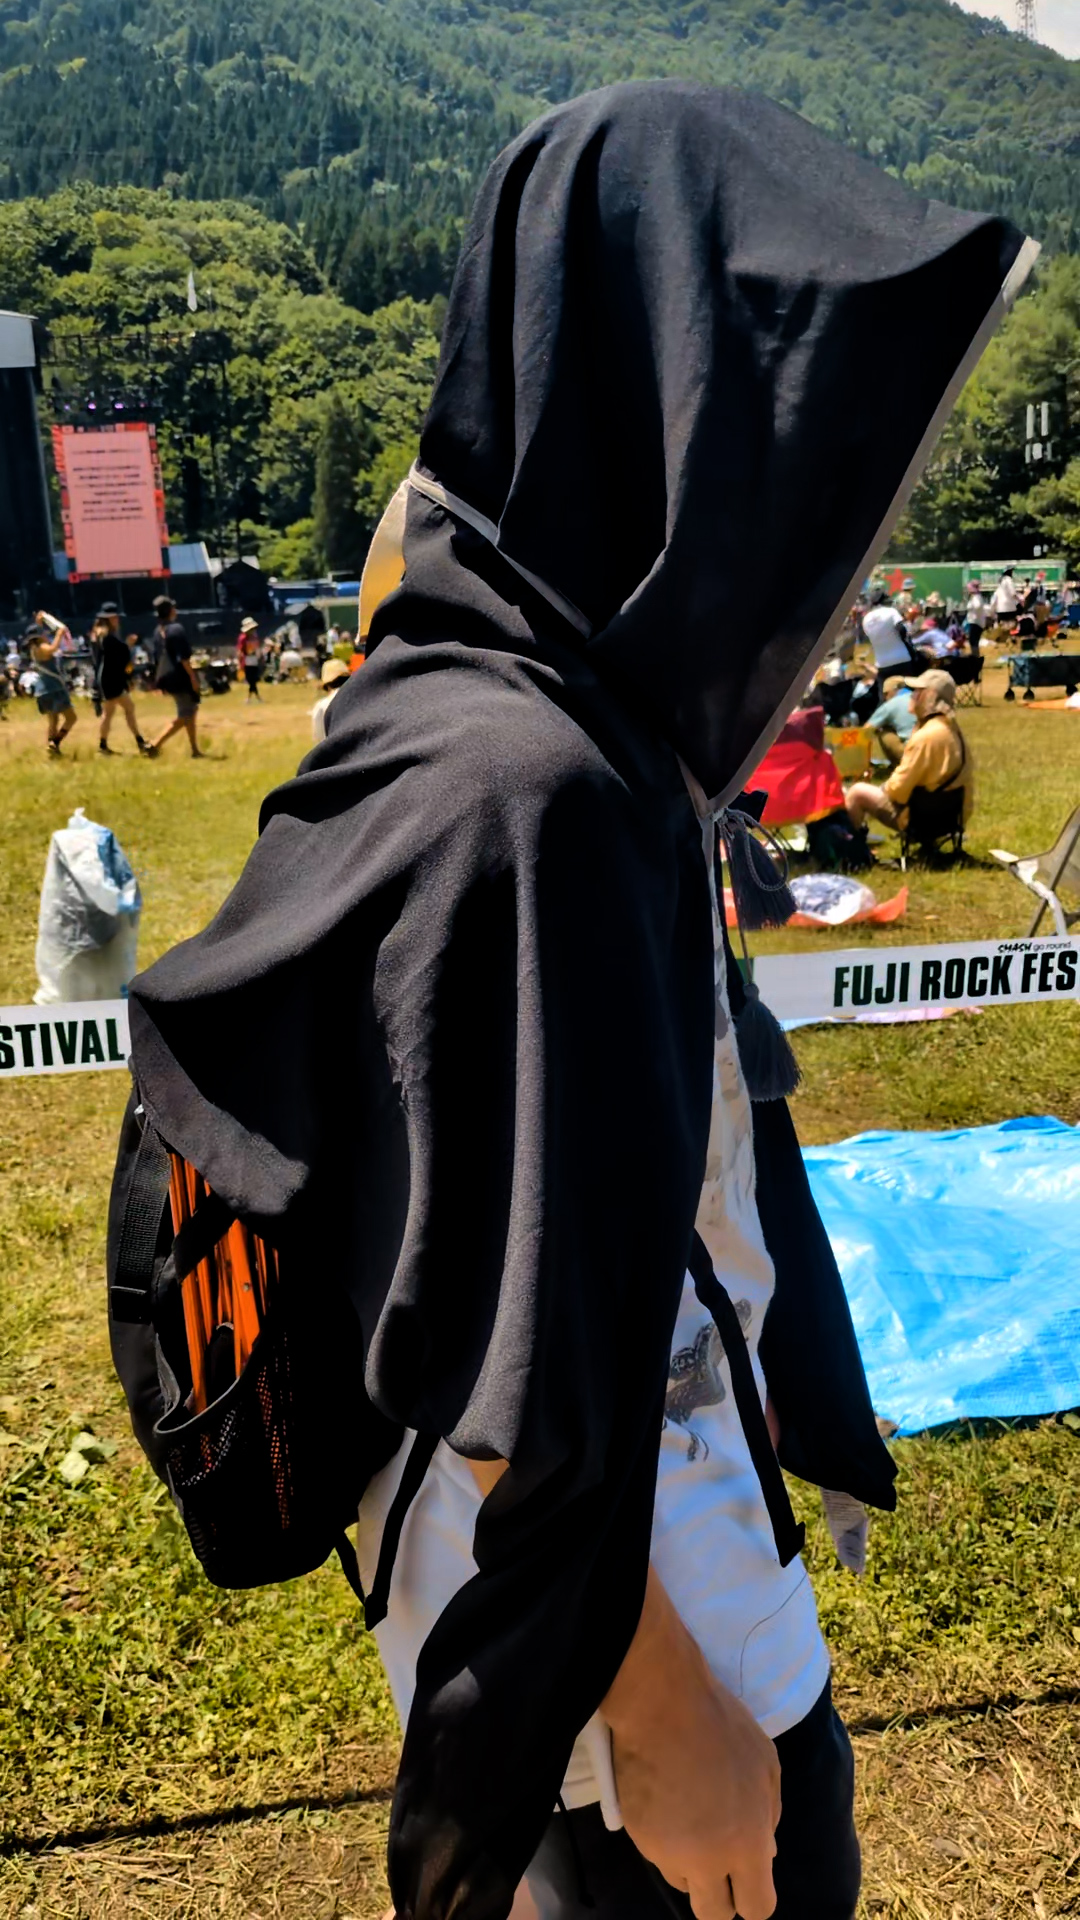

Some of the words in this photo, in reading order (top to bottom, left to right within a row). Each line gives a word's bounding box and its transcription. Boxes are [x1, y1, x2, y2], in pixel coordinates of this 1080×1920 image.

[997, 942, 1033, 954] SMASH
[1033, 944, 1045, 952] go
[1046, 941, 1072, 950] round
[833, 962, 910, 1007] FUJI
[919, 954, 1014, 1001] ROCK
[1021, 950, 1079, 994] FES
[0, 1018, 125, 1069] STIVAL
